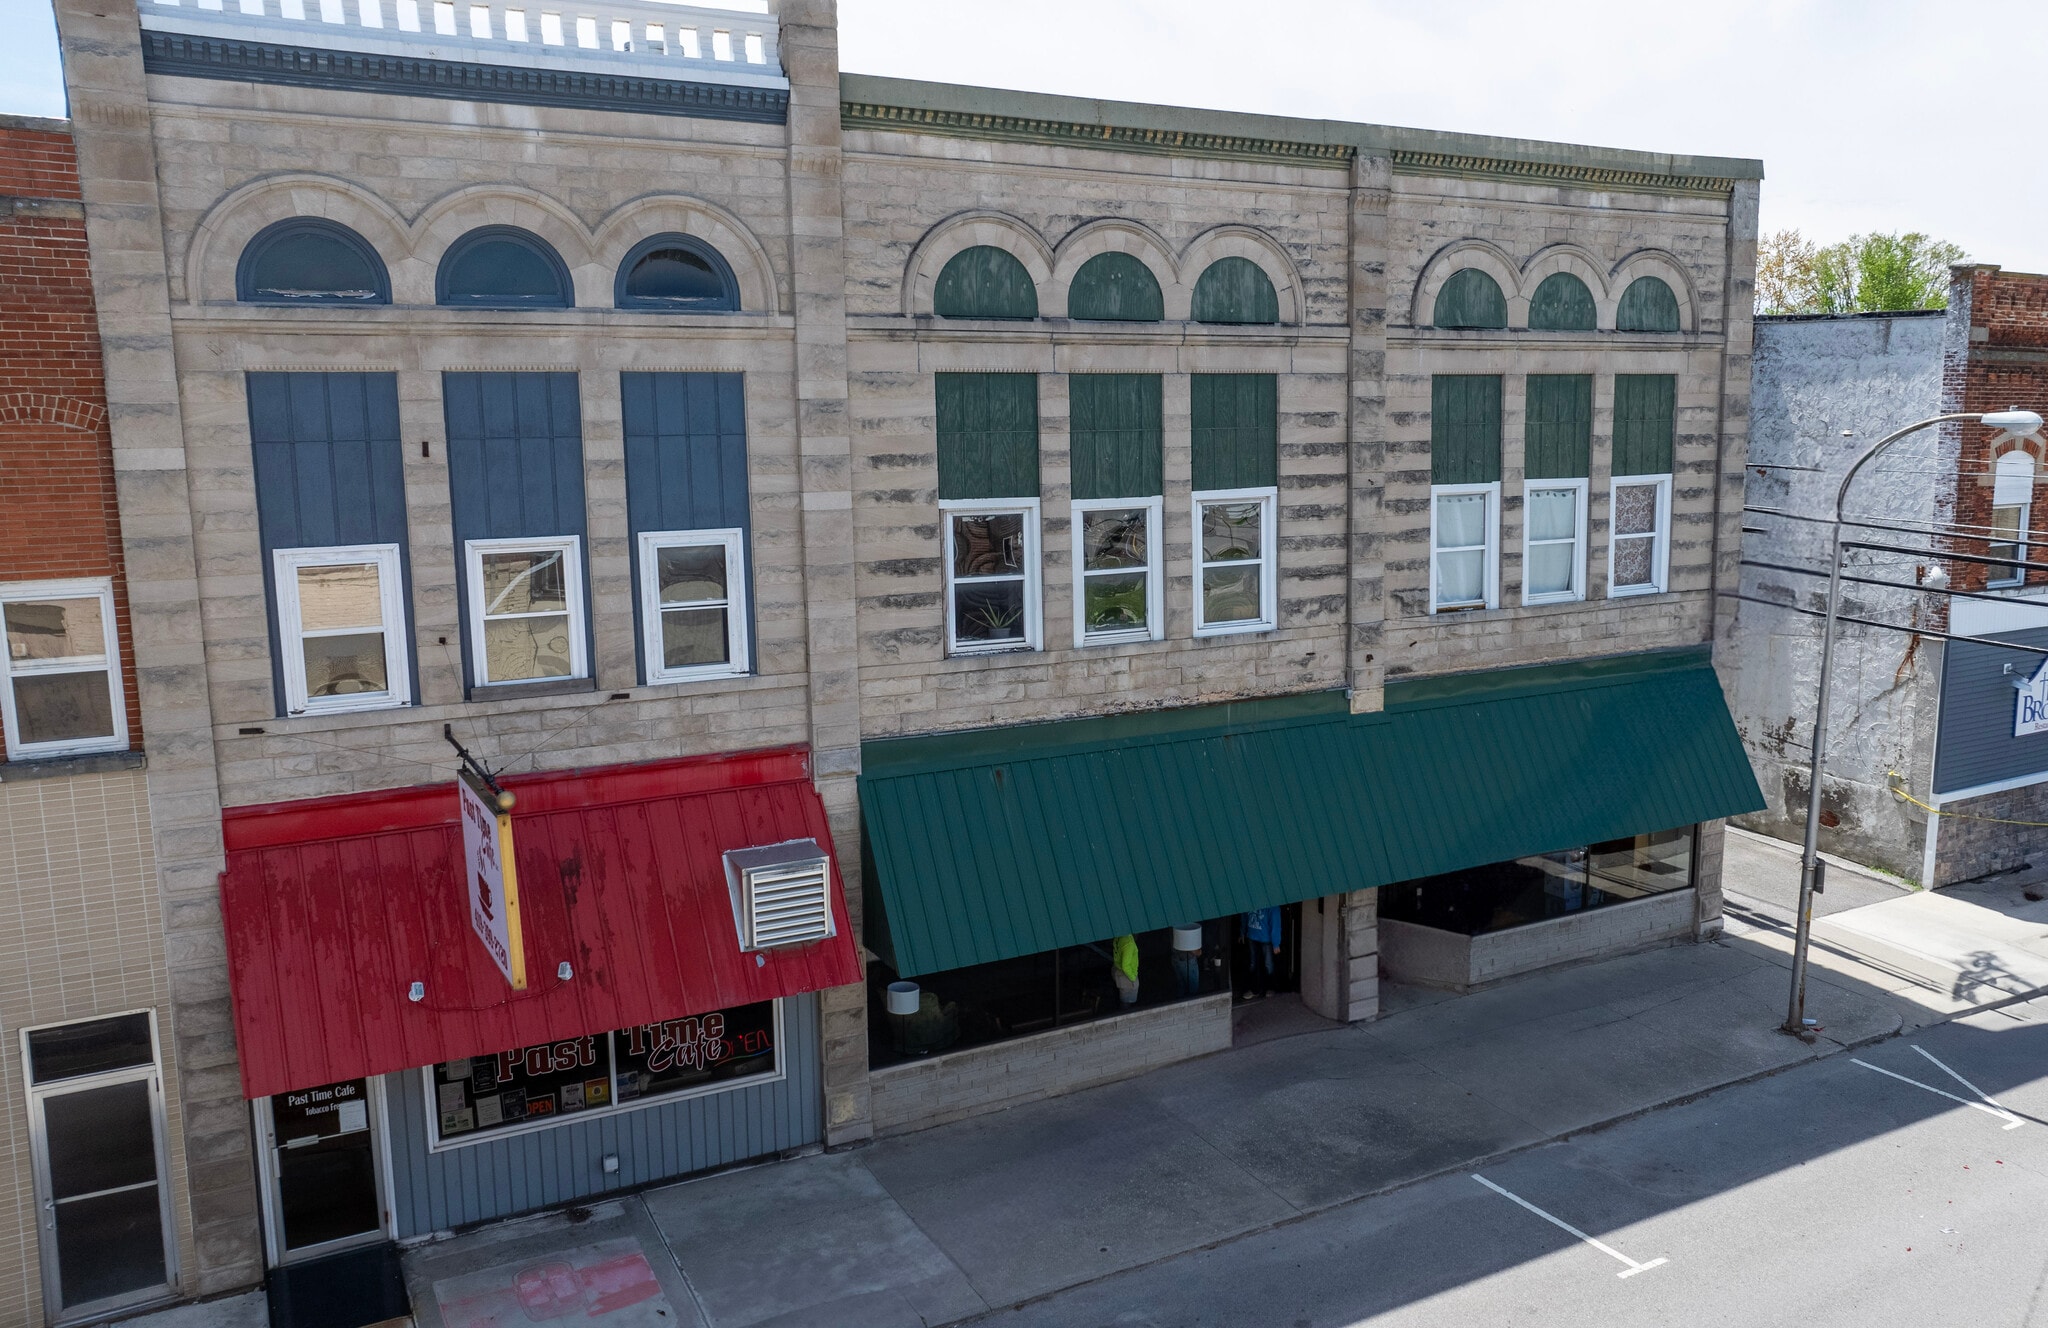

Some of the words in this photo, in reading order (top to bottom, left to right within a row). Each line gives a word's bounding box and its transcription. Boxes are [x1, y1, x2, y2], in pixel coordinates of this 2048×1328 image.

[497, 1034, 597, 1082] Past
[622, 1013, 725, 1056] Time
[647, 1030, 723, 1073] Cafe
[288, 1093, 309, 1107] Past
[310, 1089, 333, 1102] Time
[335, 1084, 356, 1097] Cafe
[305, 1105, 330, 1116] Tobacco
[330, 1102, 342, 1112] Fre
